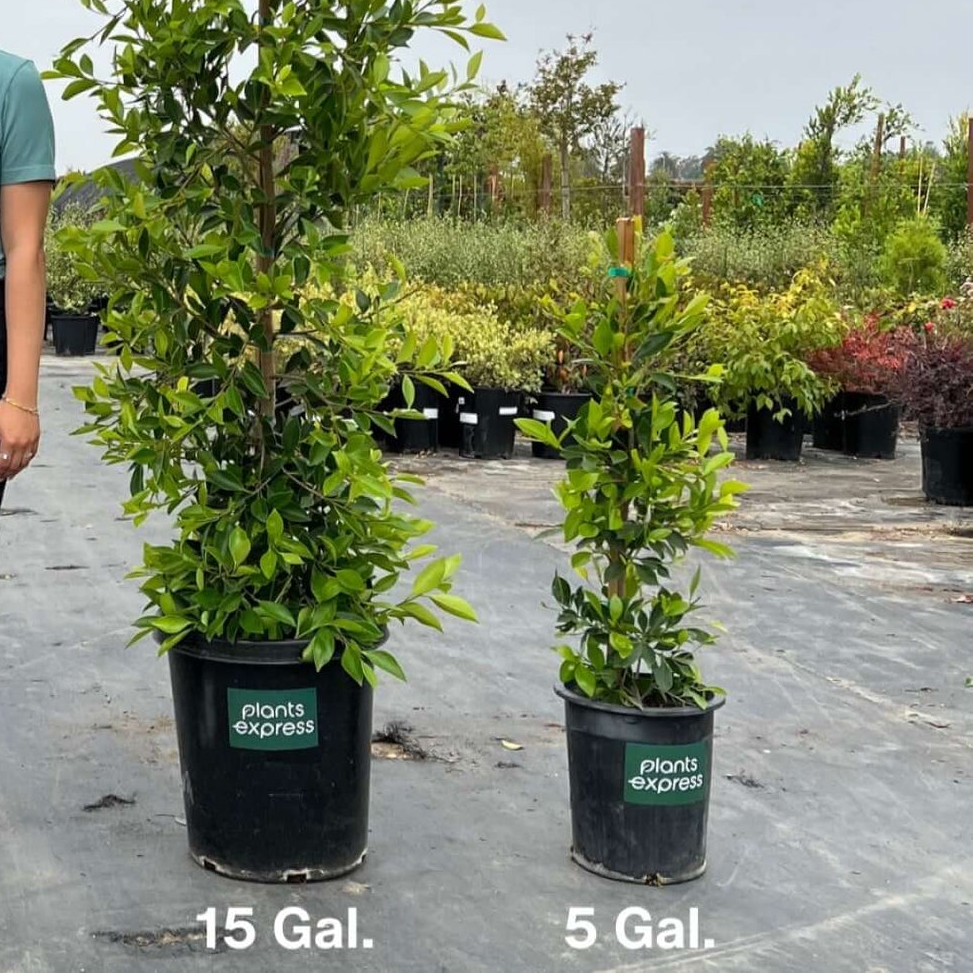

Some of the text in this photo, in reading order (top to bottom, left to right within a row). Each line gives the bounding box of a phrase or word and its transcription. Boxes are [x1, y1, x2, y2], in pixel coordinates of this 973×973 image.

[241, 701, 305, 720] plants
[232, 719, 315, 739] express
[639, 756, 698, 776] plants
[627, 773, 704, 794] express
